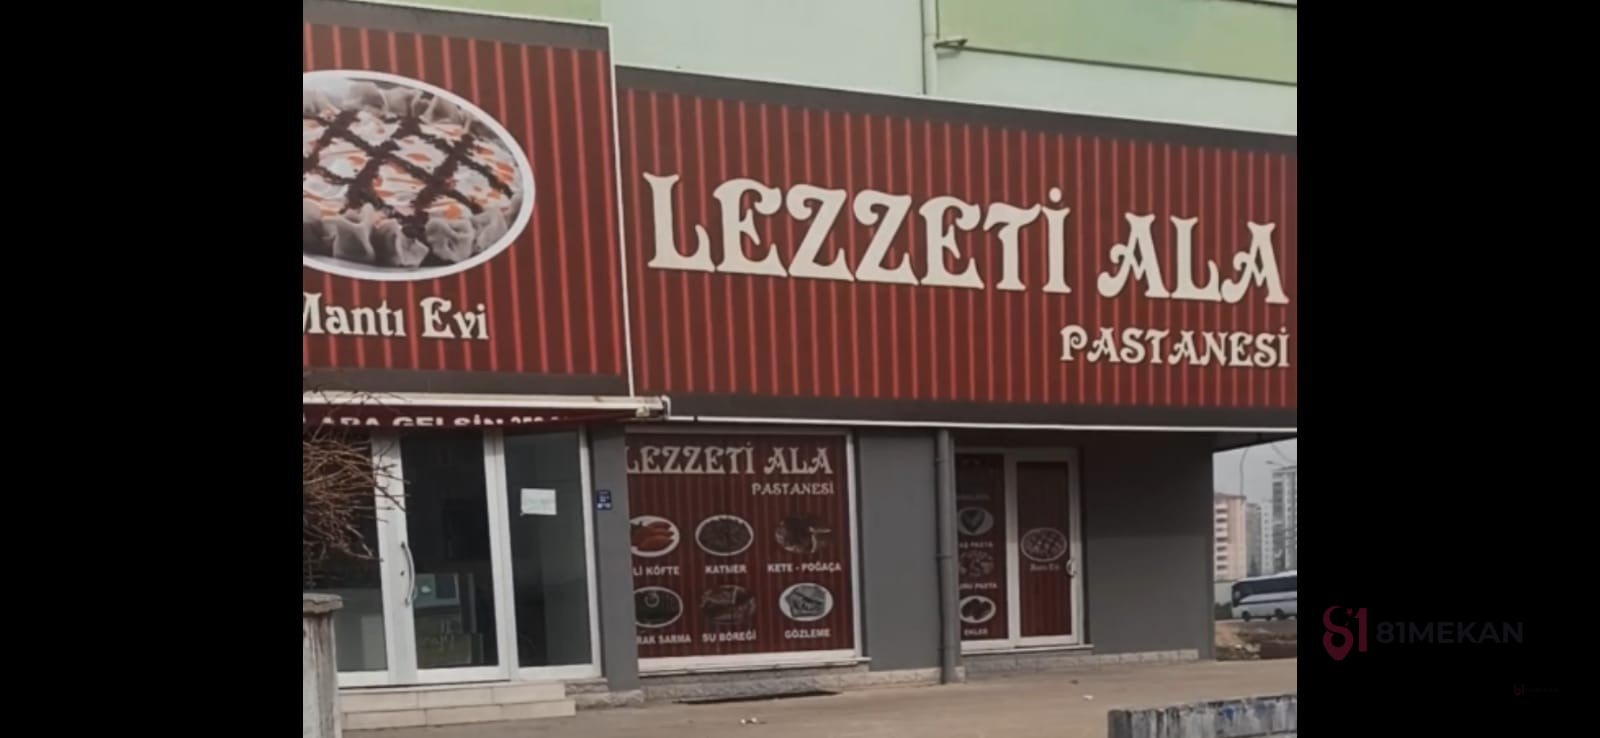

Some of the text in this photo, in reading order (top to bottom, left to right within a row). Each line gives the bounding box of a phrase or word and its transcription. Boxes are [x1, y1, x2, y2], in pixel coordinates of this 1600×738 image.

[643, 172, 1290, 305] LEZZETİ ALA
[420, 296, 489, 340] Evi
[1060, 324, 1290, 368] PASTANESİ
[765, 447, 833, 474] ALA
[752, 481, 834, 496] PASTANESİ
[646, 564, 680, 576] KÖFTE
[705, 564, 747, 574] KATMER
[767, 563, 793, 573] KETE
[801, 561, 842, 573] POĞAÇA
[702, 633, 717, 643] SU
[784, 628, 831, 639] GÖZLEME
